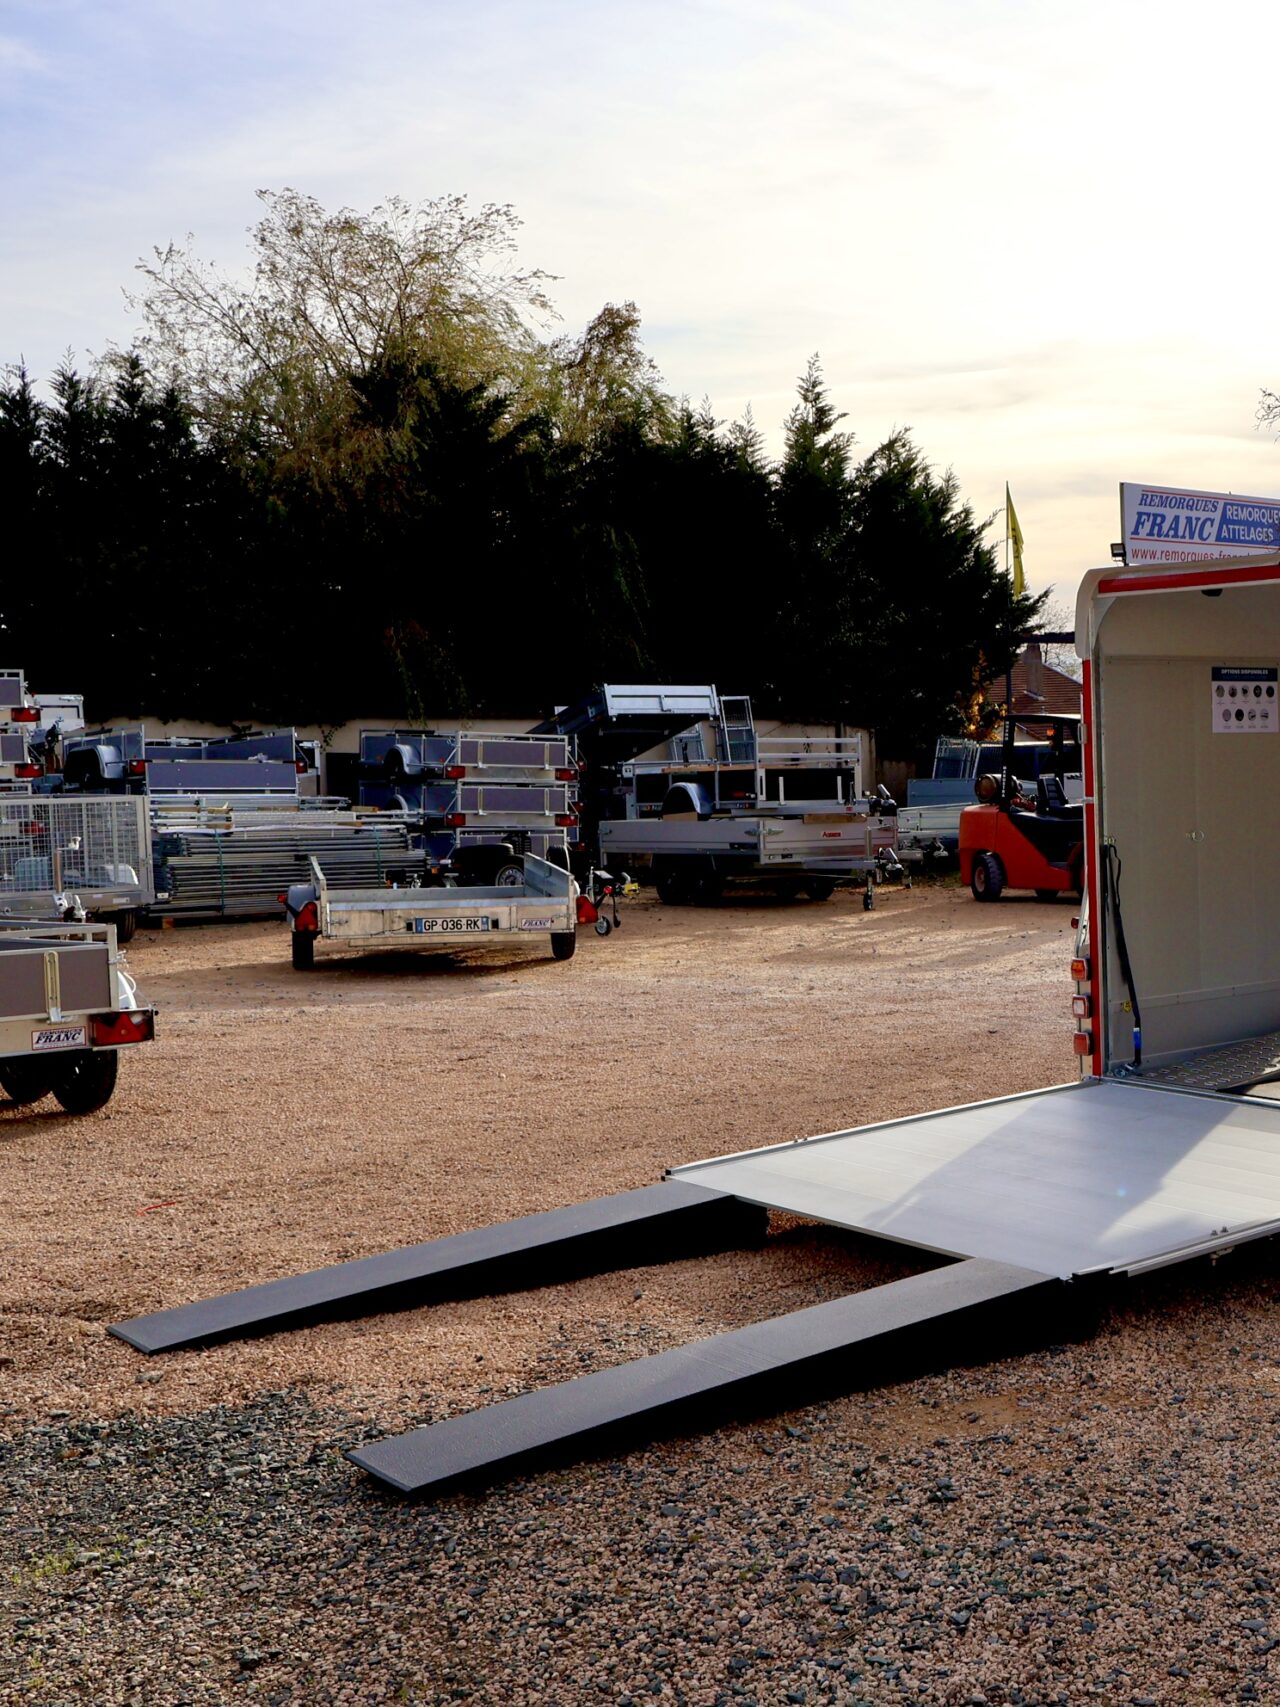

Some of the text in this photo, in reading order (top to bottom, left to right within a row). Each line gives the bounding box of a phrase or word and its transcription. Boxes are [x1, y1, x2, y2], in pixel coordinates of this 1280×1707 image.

[1138, 493, 1219, 513] REMORQUES
[1131, 511, 1215, 542] FRANC
[1221, 524, 1274, 542] ATTELAGES
[35, 1031, 81, 1044] FRANC
